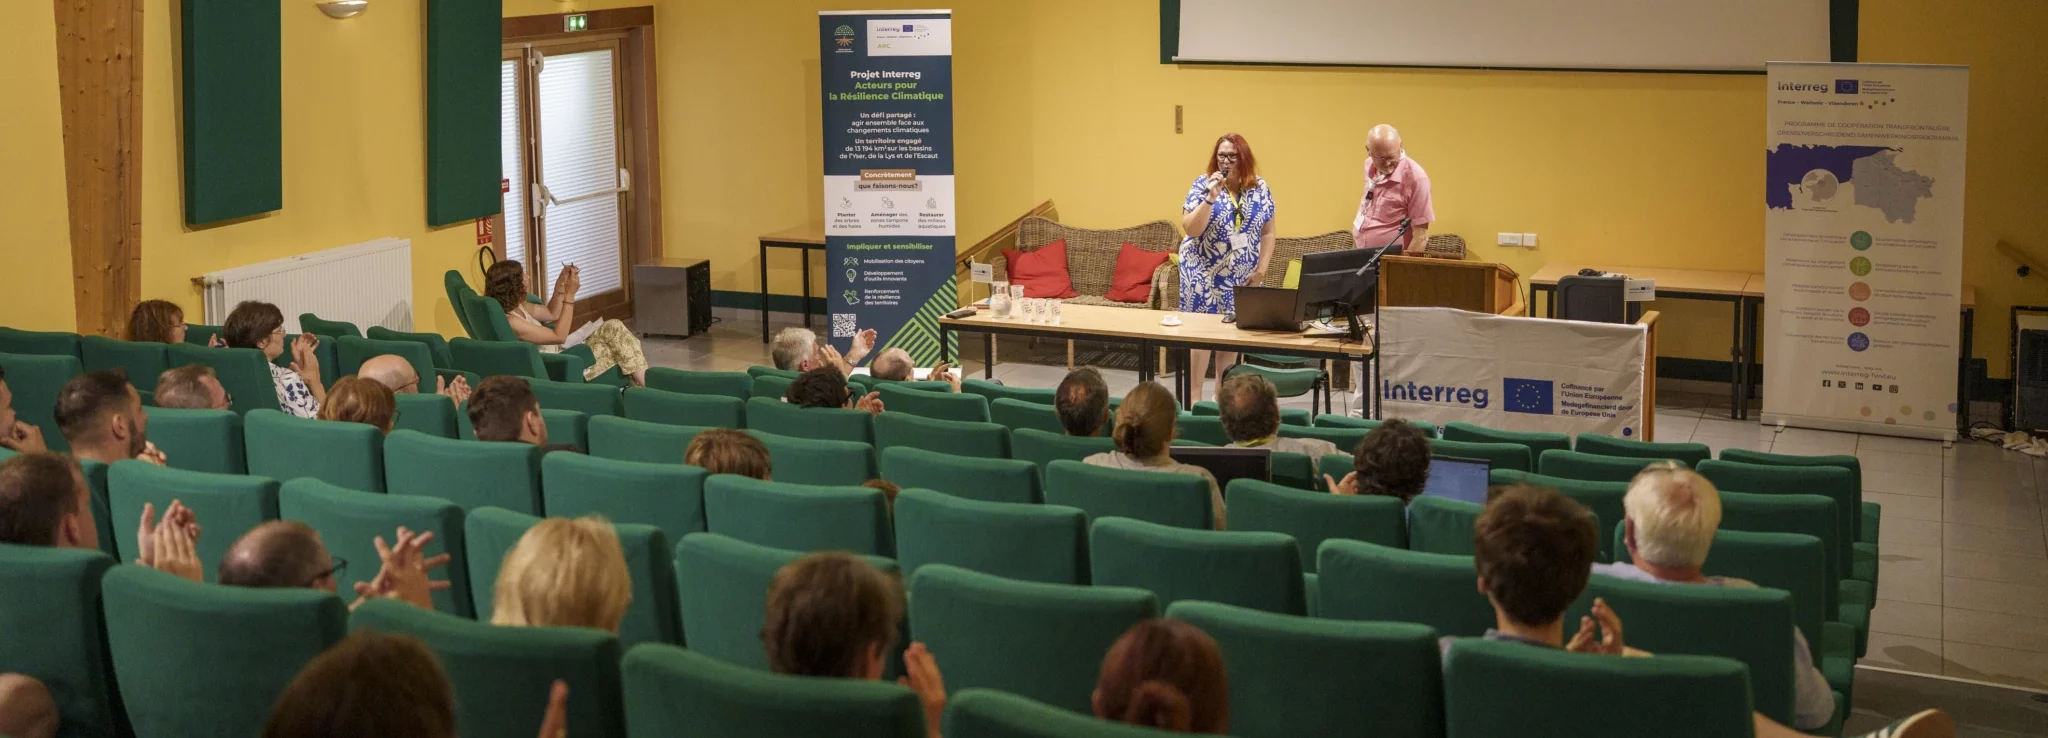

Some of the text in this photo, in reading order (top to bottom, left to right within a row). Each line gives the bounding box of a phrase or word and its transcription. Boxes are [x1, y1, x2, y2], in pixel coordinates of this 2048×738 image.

[850, 70, 921, 80] Projet Interreg
[895, 82, 917, 90] pour
[840, 92, 889, 100] Résilience
[892, 91, 944, 101] Climatique
[1561, 383, 1592, 391] Cofinancé
[1383, 379, 1489, 409] Interreg
[1561, 400, 1616, 410] Medegefinancierd
